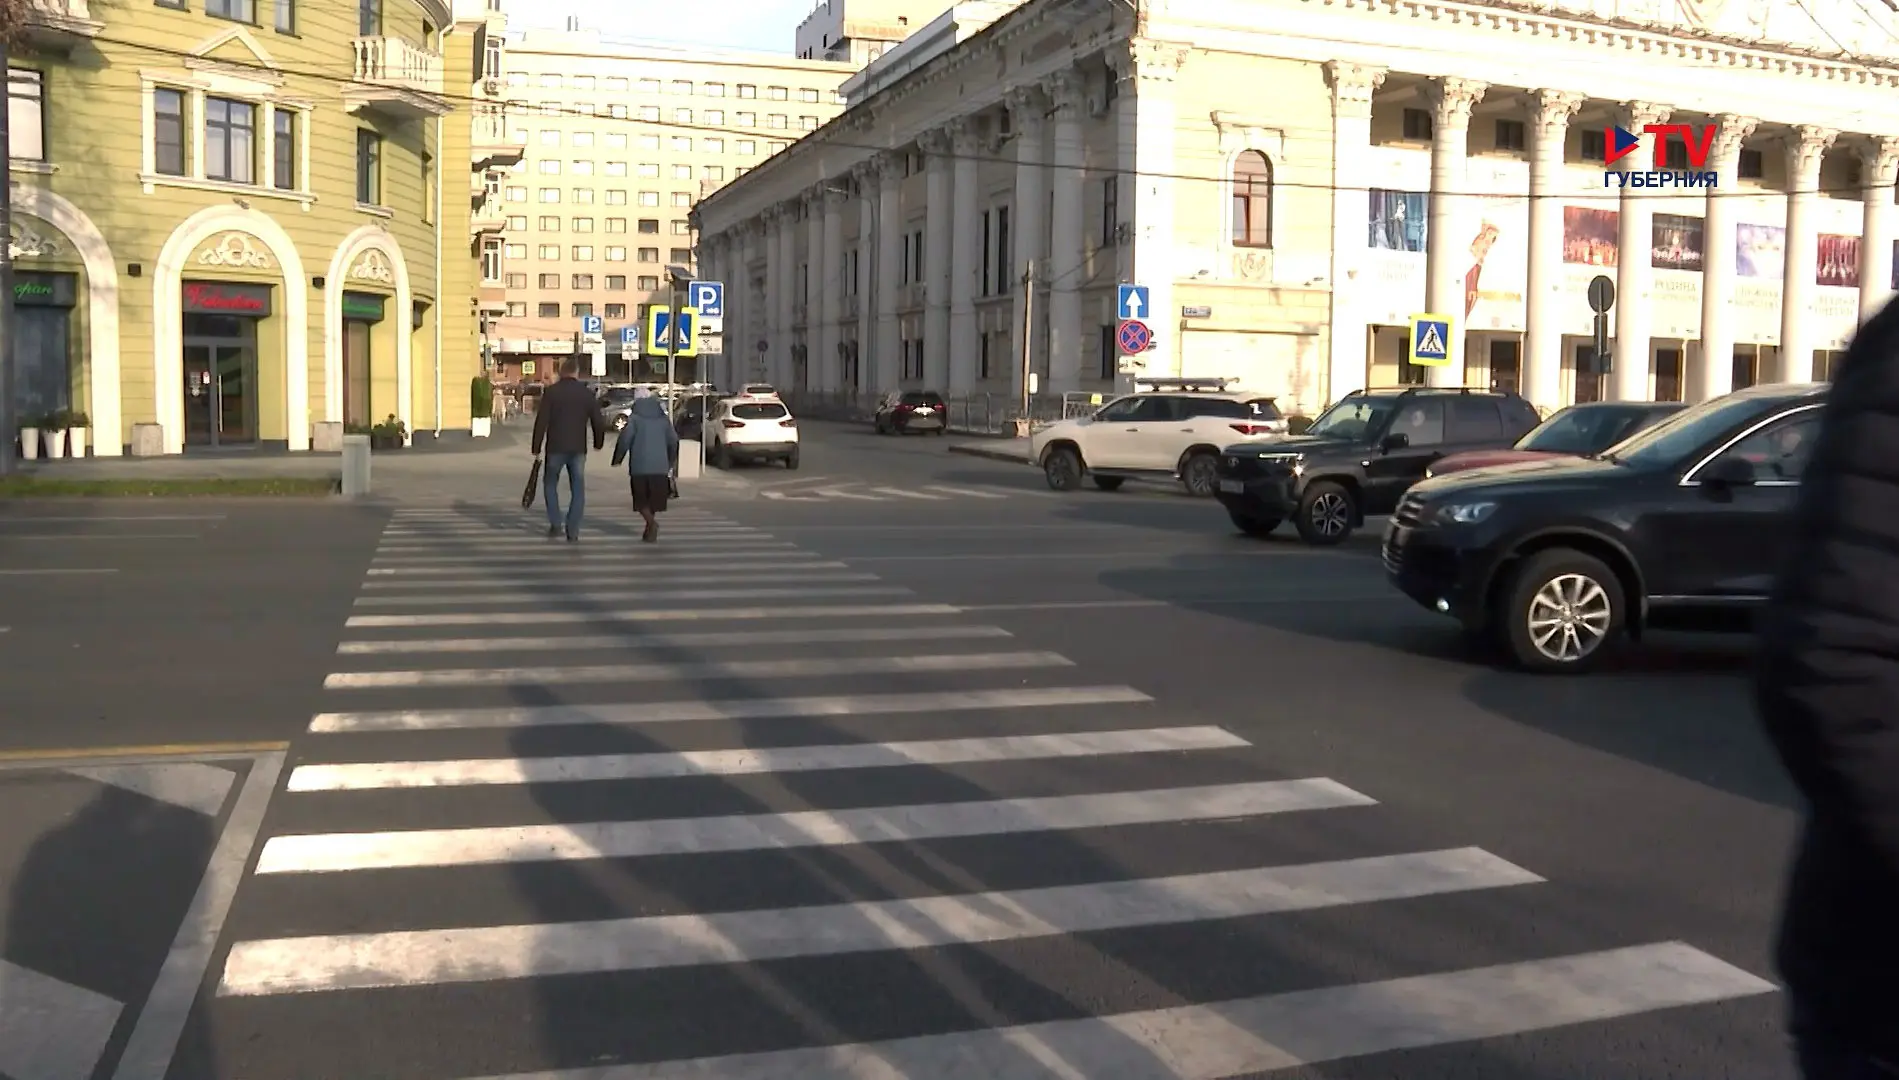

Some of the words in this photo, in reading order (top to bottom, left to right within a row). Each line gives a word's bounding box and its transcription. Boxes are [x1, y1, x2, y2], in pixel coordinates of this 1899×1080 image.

[698, 286, 717, 314] P
[588, 317, 600, 333] P
[626, 328, 637, 343] P
